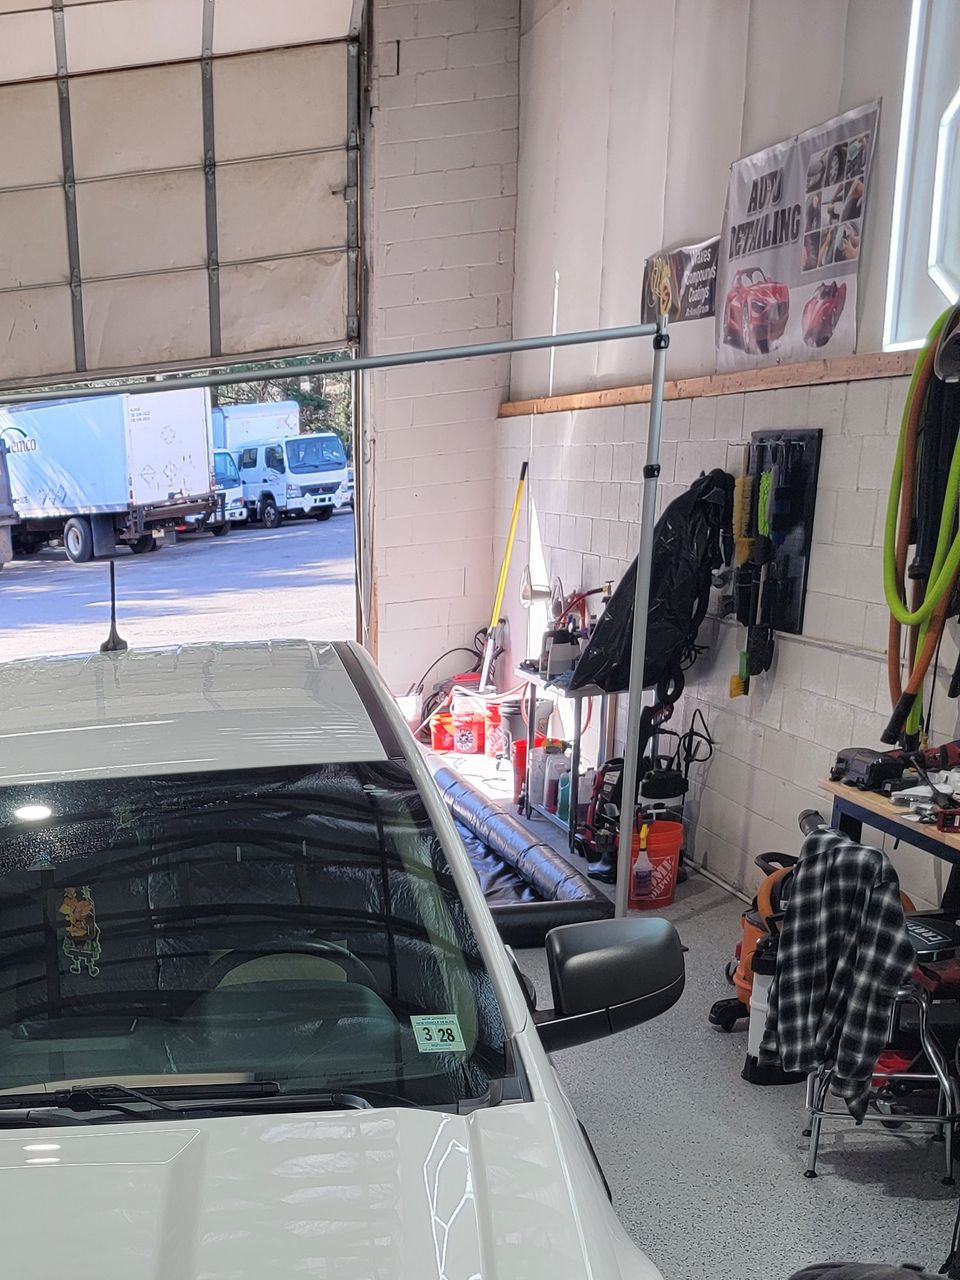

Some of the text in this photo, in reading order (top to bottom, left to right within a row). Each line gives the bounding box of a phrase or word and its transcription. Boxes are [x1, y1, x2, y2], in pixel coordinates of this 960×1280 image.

[746, 167, 784, 217] AUTO
[728, 203, 802, 261] DETAILING
[685, 265, 716, 287] Compounds
[422, 1027, 455, 1042] 3 28
